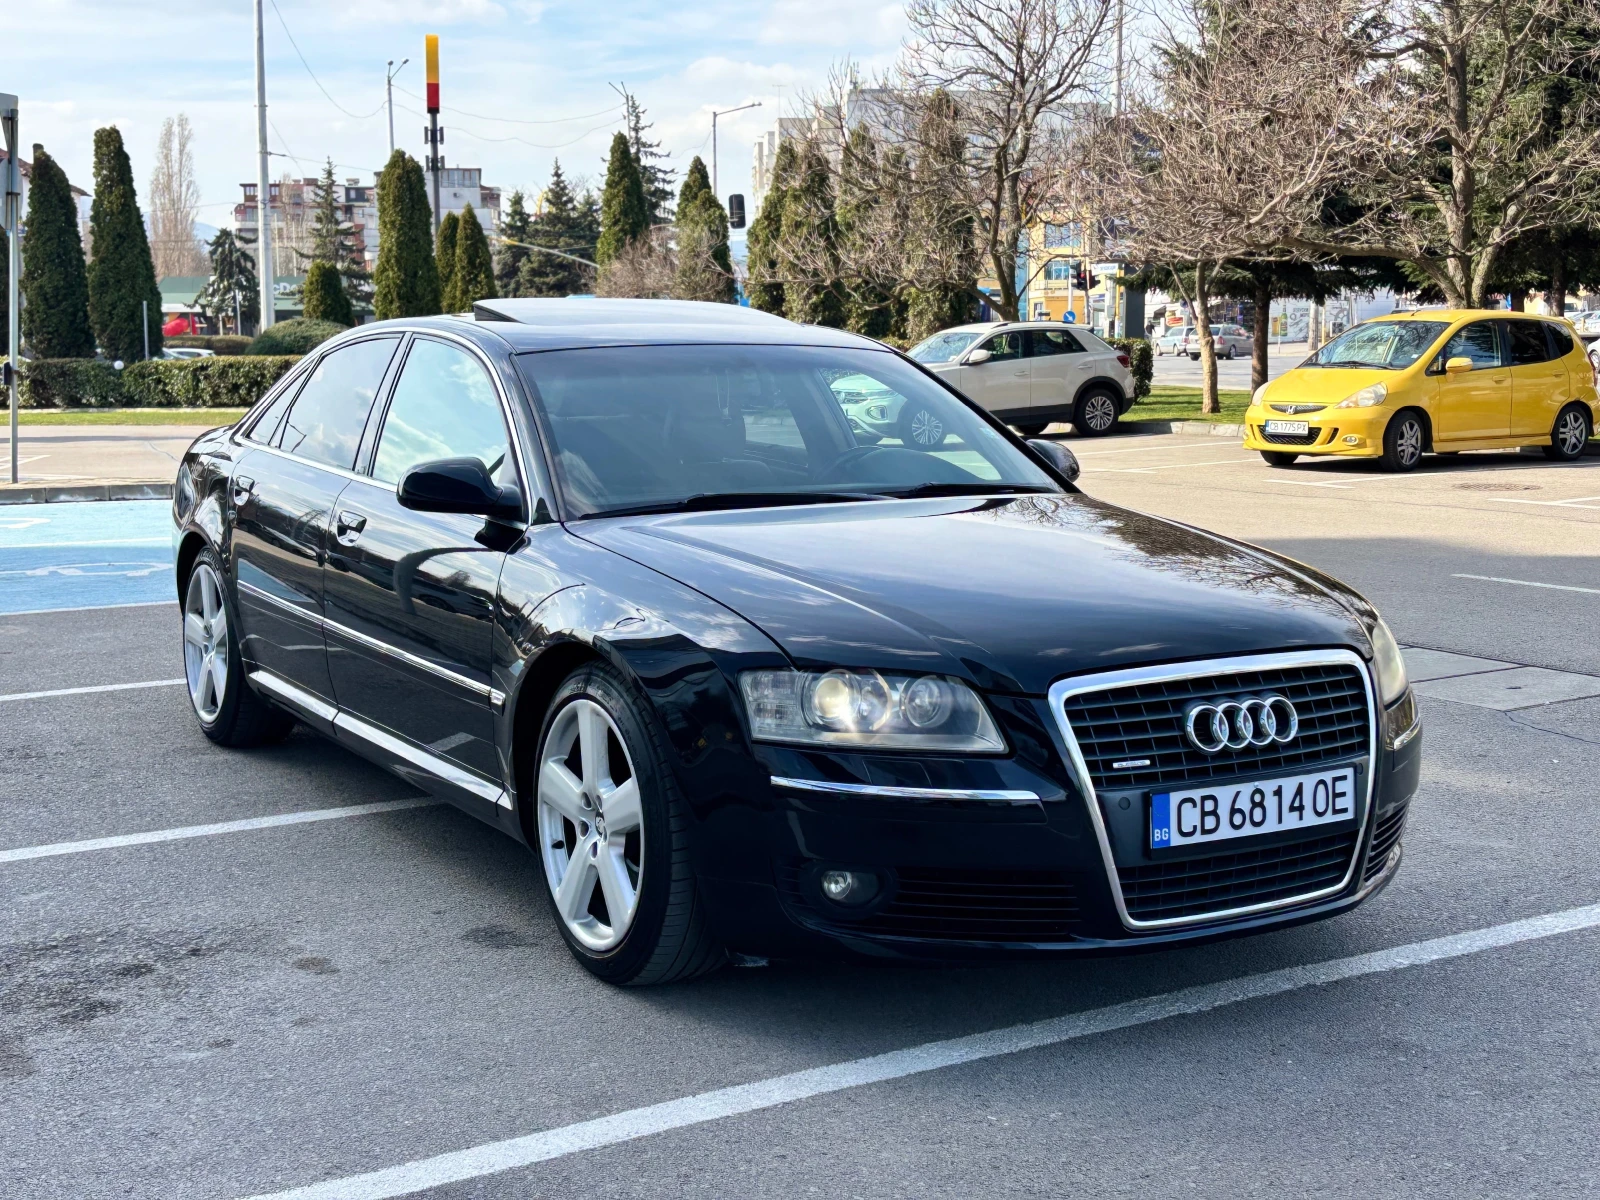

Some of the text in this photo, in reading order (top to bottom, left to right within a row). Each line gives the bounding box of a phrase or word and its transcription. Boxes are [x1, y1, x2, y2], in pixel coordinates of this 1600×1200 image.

[1270, 422, 1307, 432] CB 1775 PX
[1176, 774, 1349, 838] CB 6814 OE
[1154, 828, 1169, 842] BG
